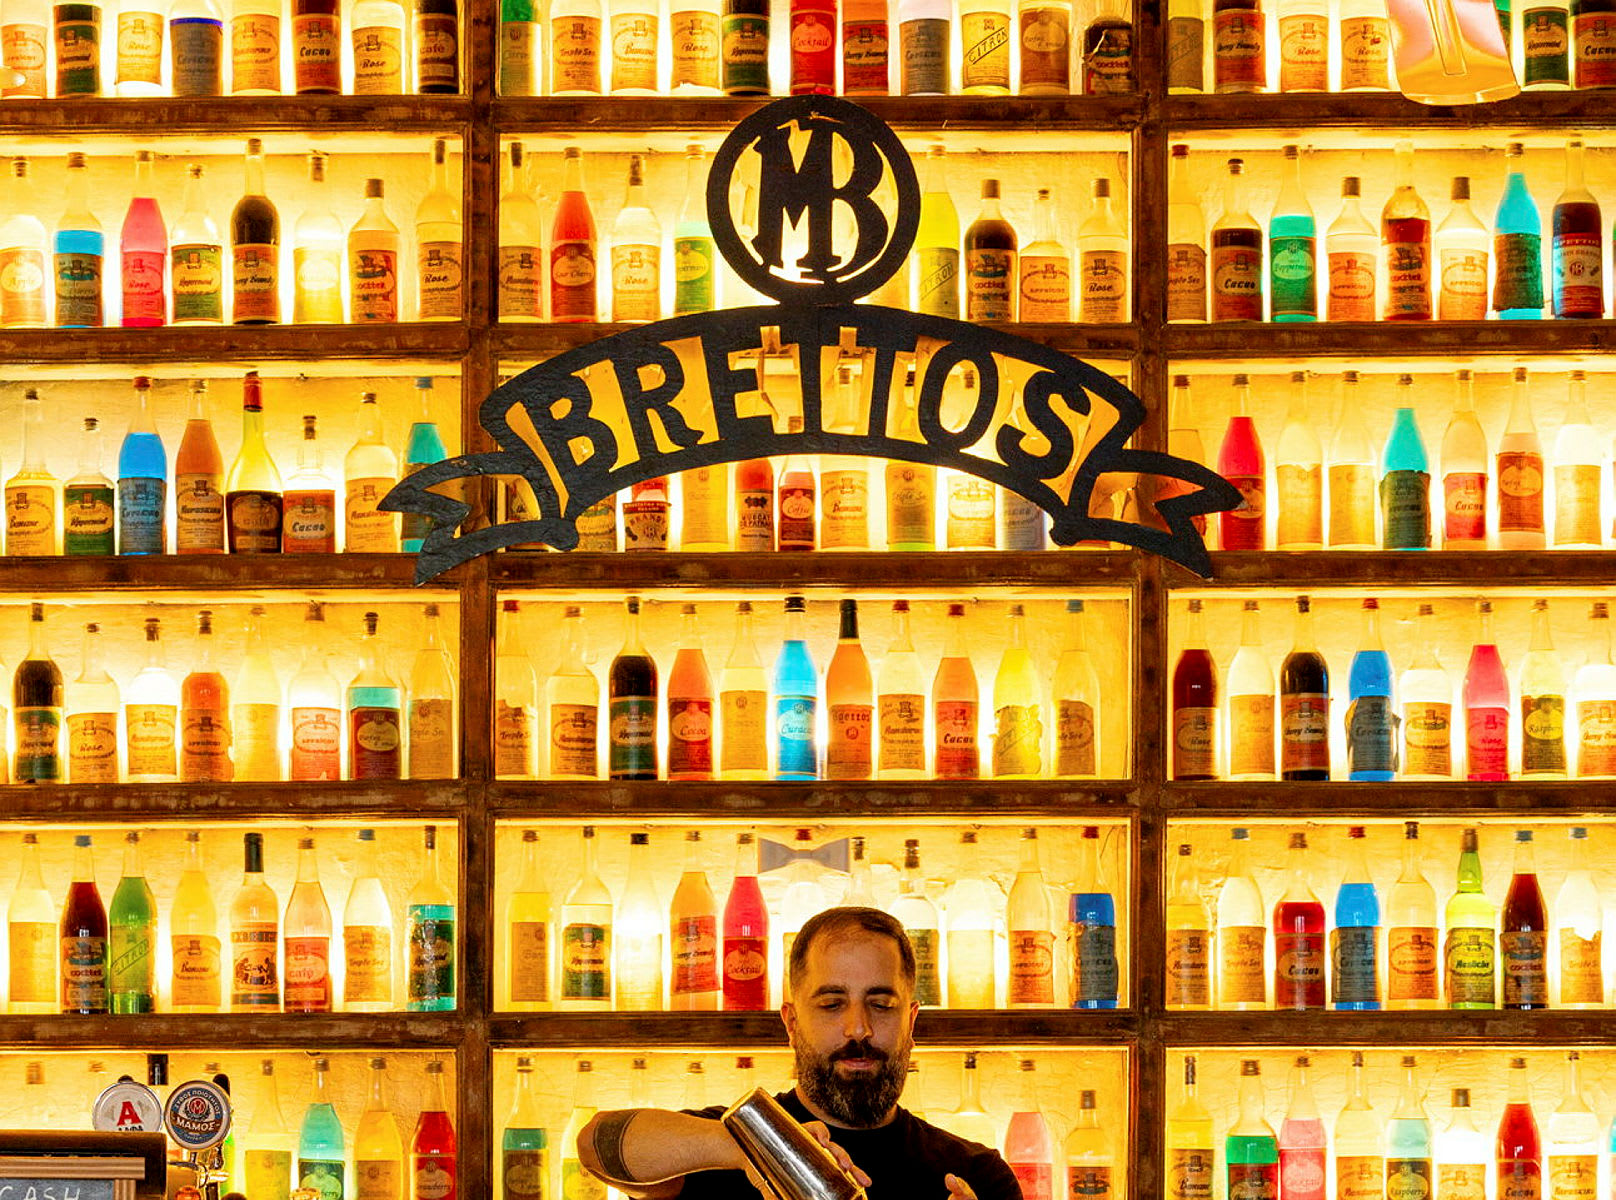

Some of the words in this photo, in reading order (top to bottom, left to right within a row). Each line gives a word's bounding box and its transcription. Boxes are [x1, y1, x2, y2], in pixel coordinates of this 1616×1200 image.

[299, 45, 331, 56] Cacao
[682, 43, 708, 54] Rose
[968, 28, 1008, 63] CITRON
[1297, 46, 1322, 56] Rose
[361, 58, 386, 68] Rose
[426, 273, 449, 284] Rose
[1223, 278, 1256, 290] Cacao
[1089, 282, 1114, 292] Rose
[538, 328, 1091, 486] BRETTOS
[291, 521, 326, 533] Cacao
[79, 742, 105, 752] Rose
